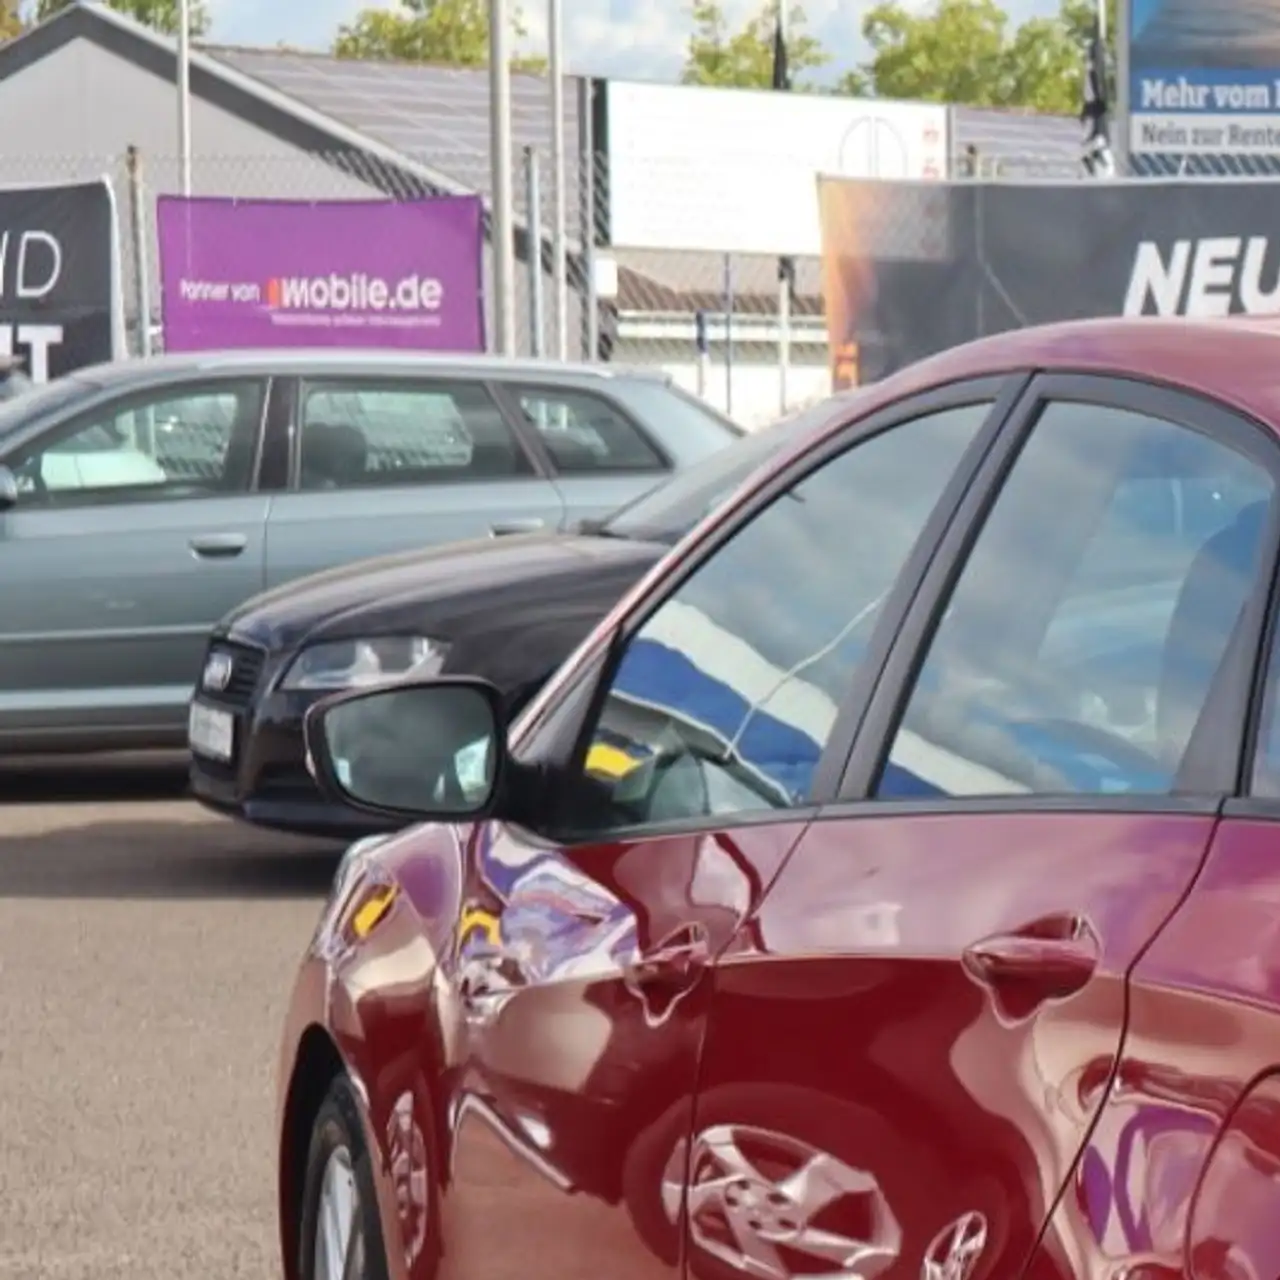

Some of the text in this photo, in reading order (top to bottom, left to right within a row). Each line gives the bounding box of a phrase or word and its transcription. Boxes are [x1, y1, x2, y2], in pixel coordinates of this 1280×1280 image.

[1141, 76, 1210, 109] Mehr
[1213, 83, 1270, 109] vom
[1142, 121, 1188, 146] Nein
[1192, 126, 1223, 146] zur
